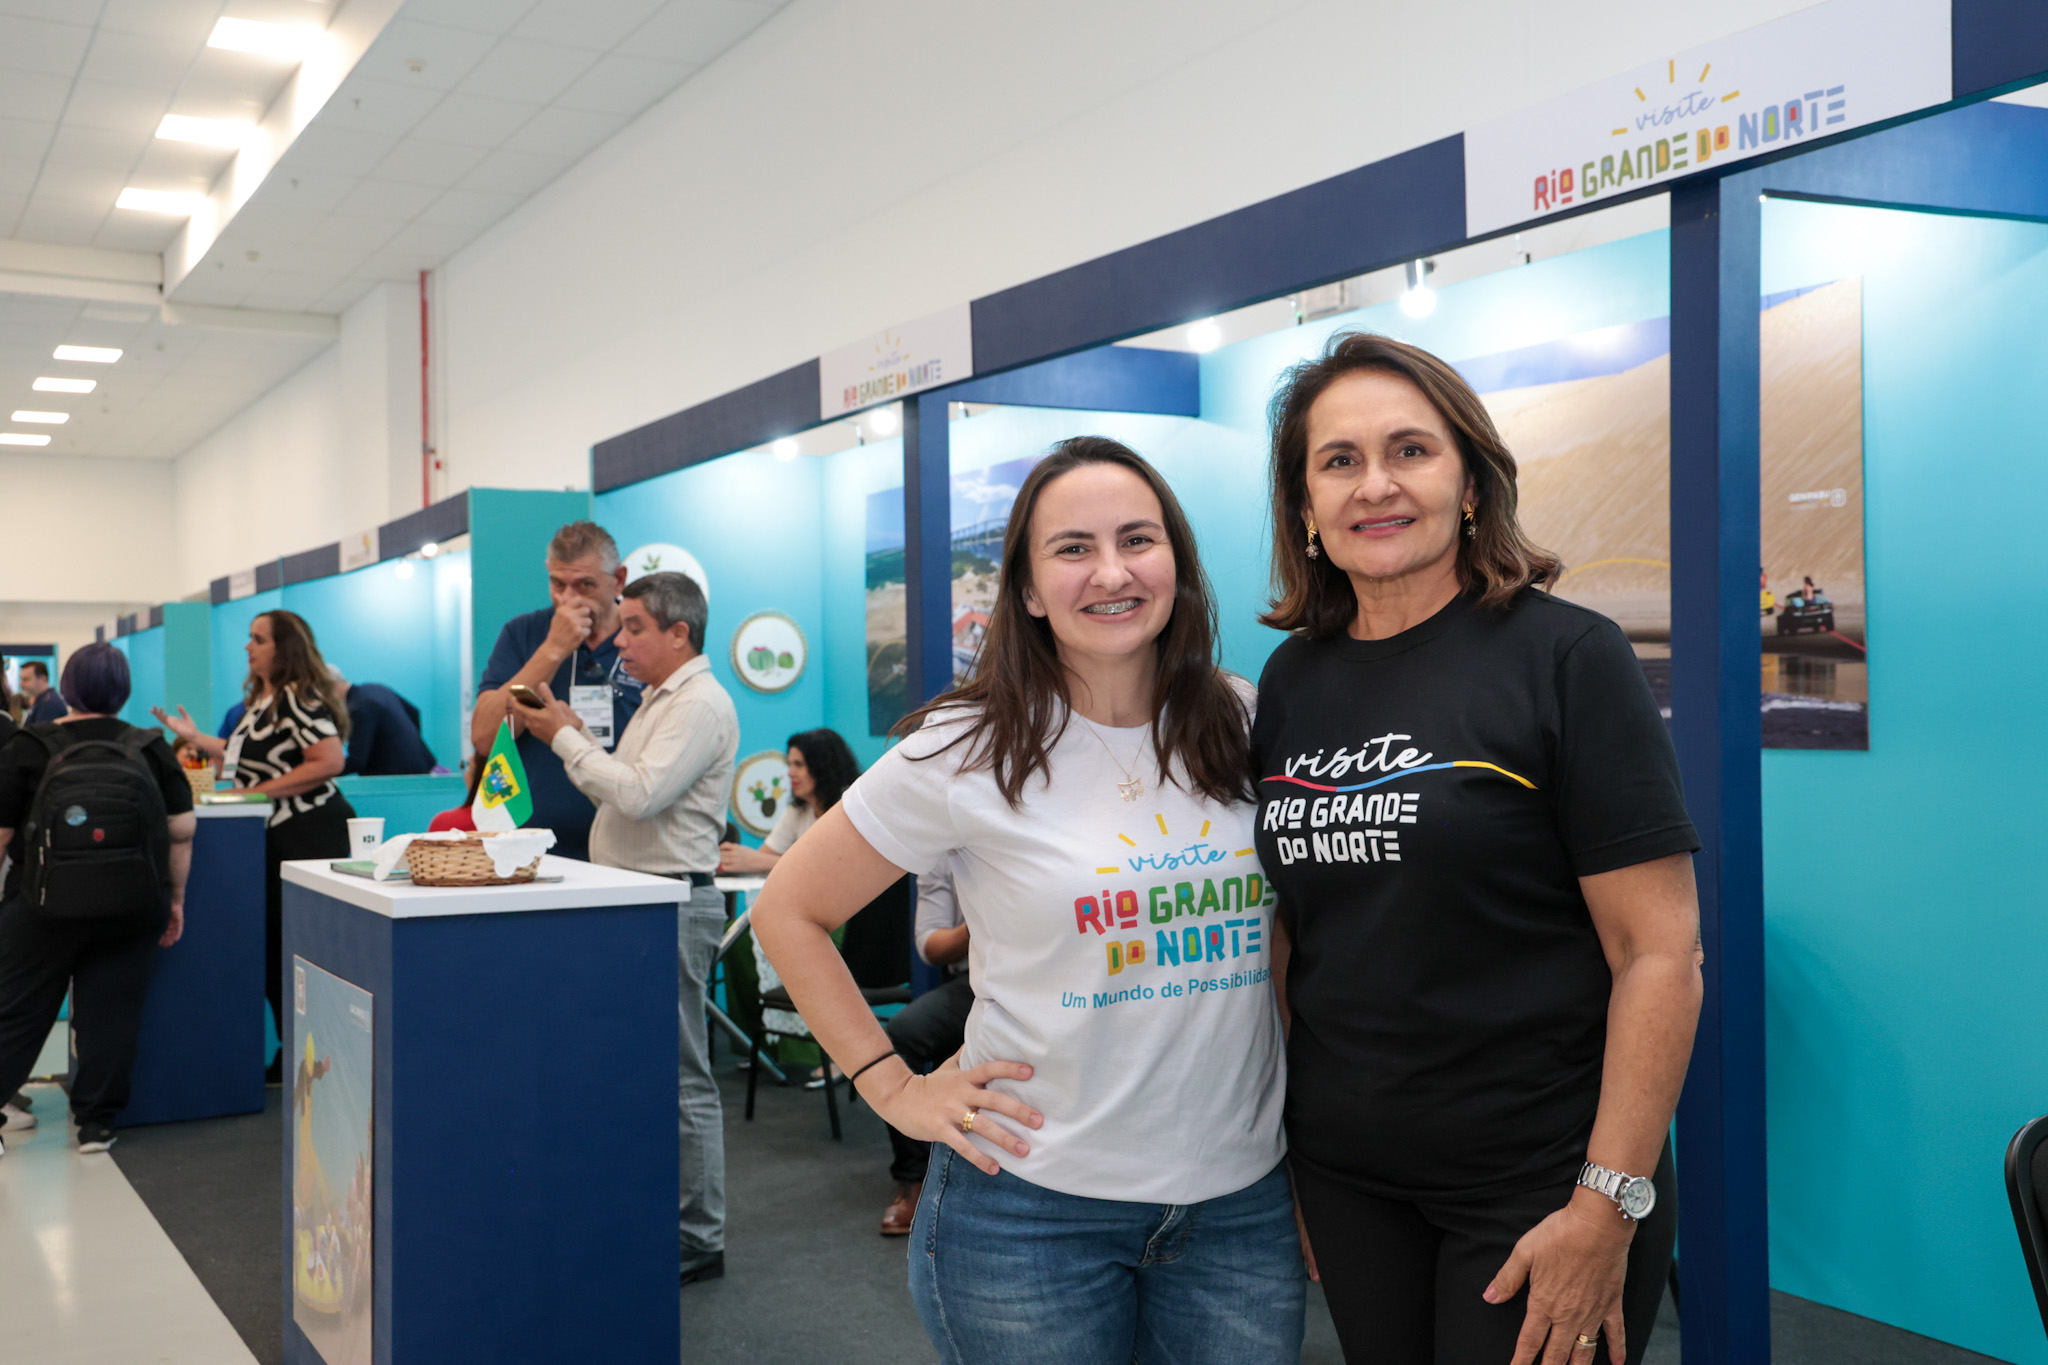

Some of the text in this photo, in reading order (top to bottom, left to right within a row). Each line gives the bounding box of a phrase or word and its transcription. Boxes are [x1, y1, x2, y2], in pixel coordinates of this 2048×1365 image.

[1635, 90, 1716, 131] visite
[1582, 132, 1689, 199] GRANDE
[1739, 85, 1846, 151] NORTE
[1285, 733, 1433, 779] visite
[1310, 793, 1420, 828] GRANDE
[1128, 843, 1227, 872] visite
[1312, 829, 1401, 864] NORTE
[1149, 873, 1276, 925] GRANDE
[1156, 917, 1261, 967] NORTE
[1061, 992, 1087, 1009] Um
[1093, 985, 1155, 1009] Mundo
[1161, 982, 1183, 999] de
